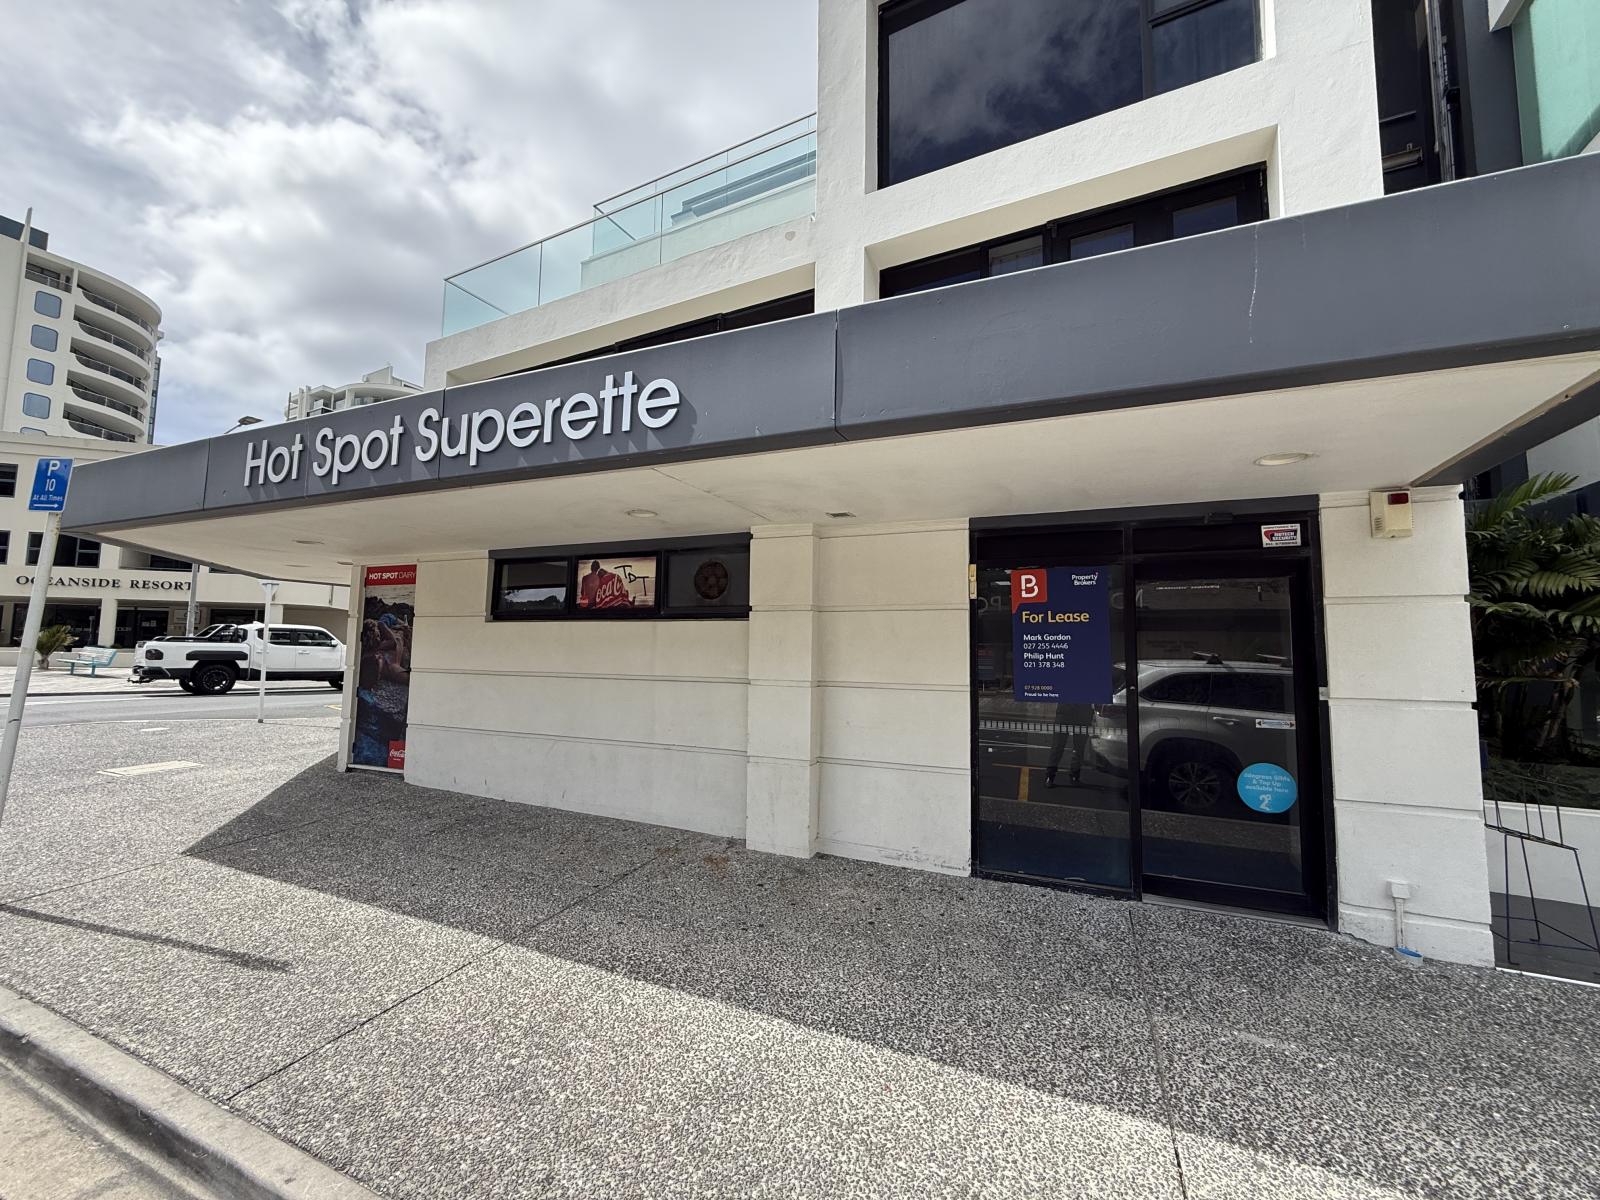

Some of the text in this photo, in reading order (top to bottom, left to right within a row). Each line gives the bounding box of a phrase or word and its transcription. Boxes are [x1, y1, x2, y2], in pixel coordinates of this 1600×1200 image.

[243, 370, 681, 487] Hot Spot Superette
[47, 460, 60, 476] P
[45, 478, 56, 491] 10
[382, 572, 398, 580] SPOT
[399, 571, 416, 579] DAIRY
[1071, 573, 1098, 581] Property
[16, 575, 192, 591] OANSIDE RESORT
[1022, 610, 1090, 623] For Lease
[1023, 652, 1064, 660] Philip Hunt
